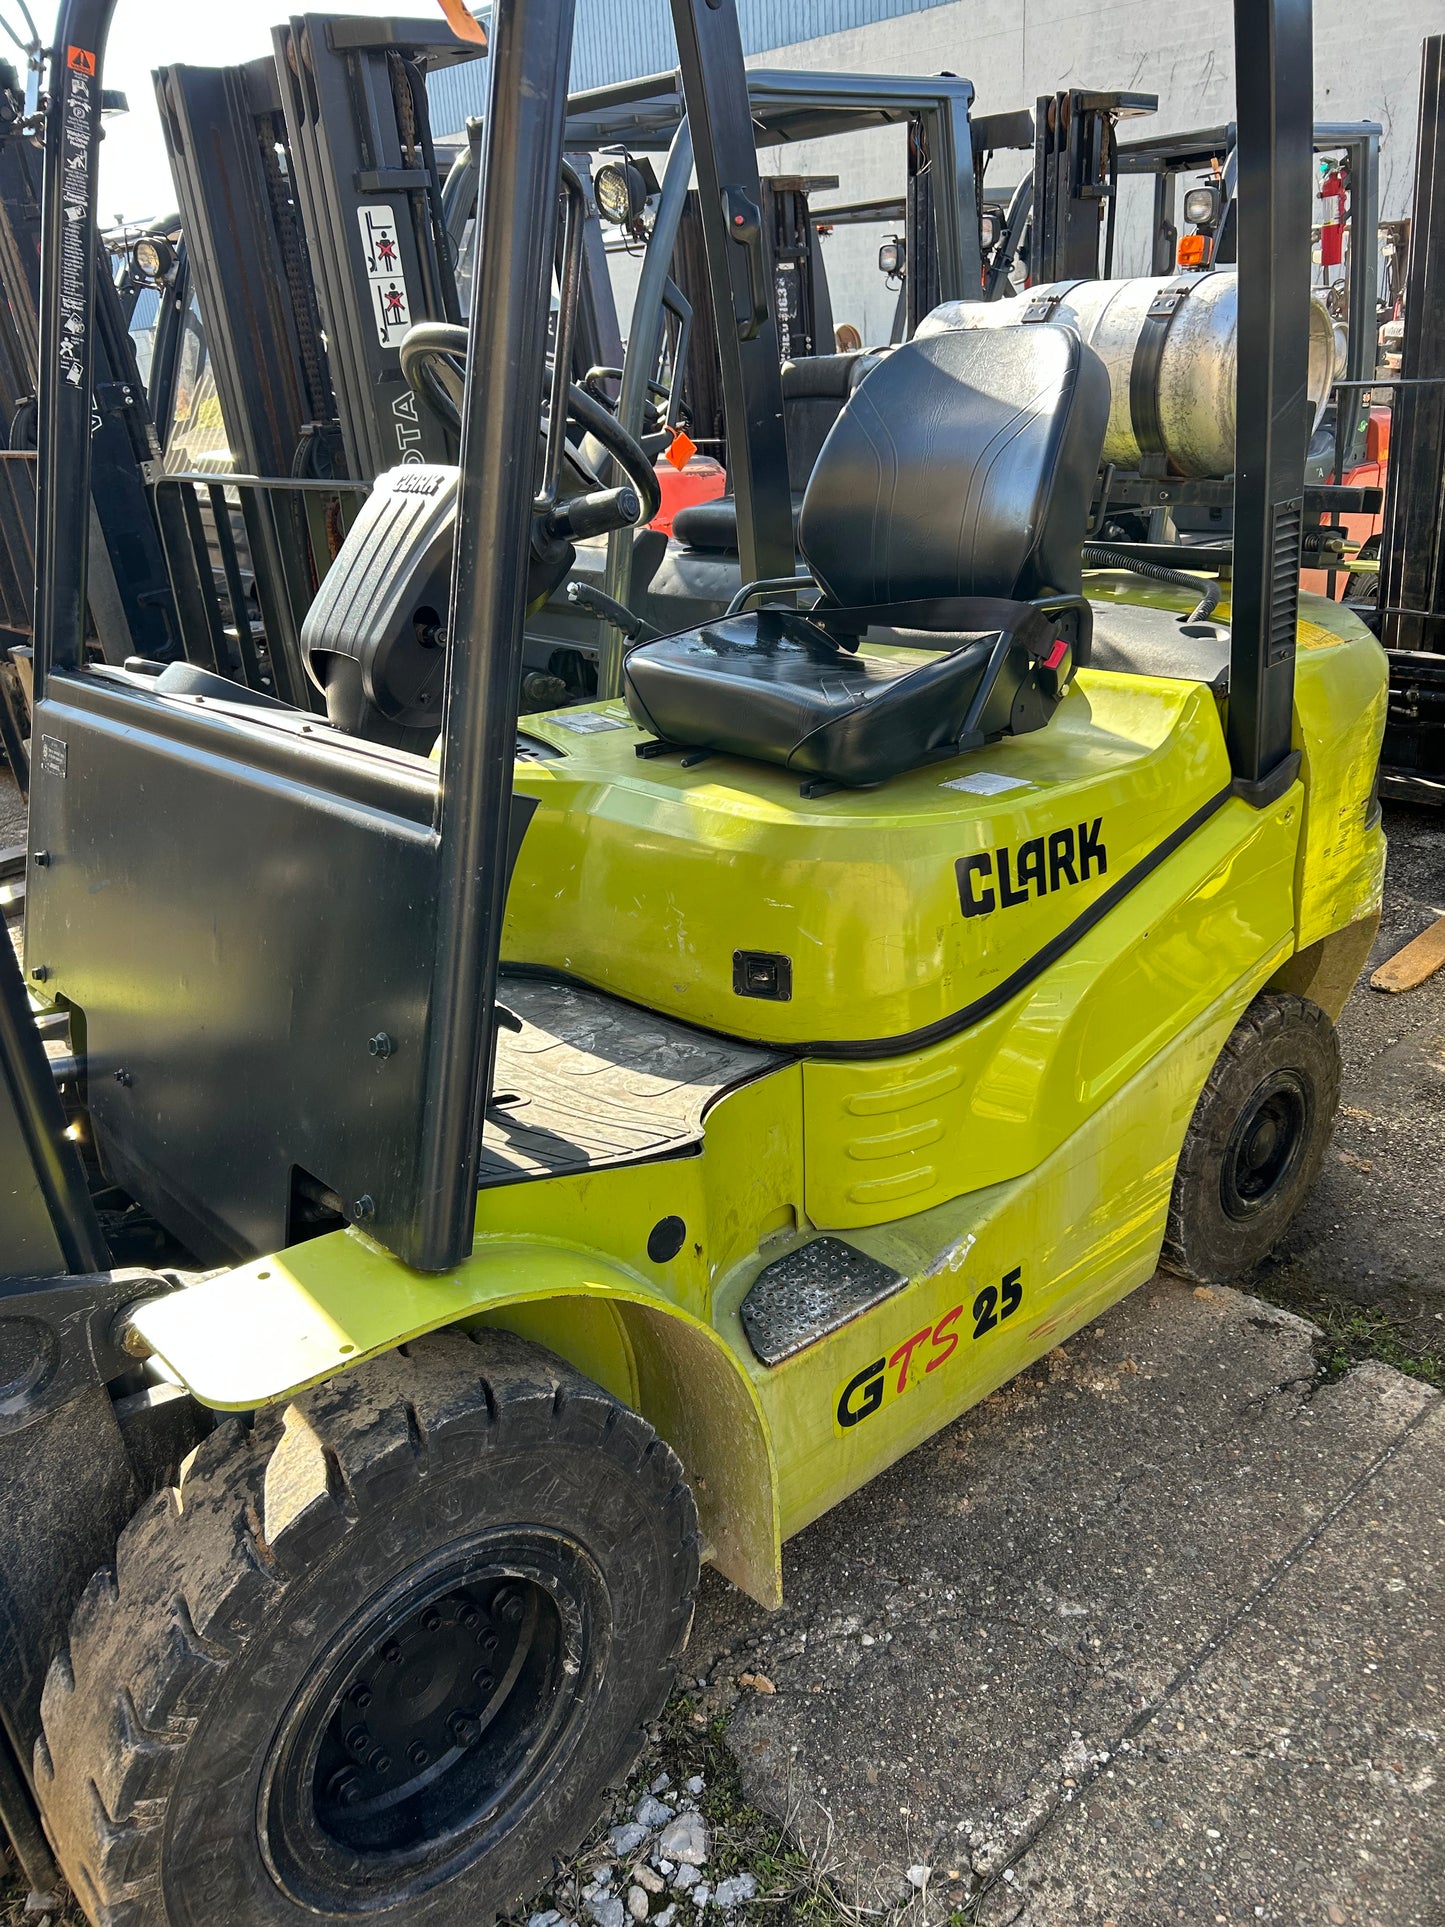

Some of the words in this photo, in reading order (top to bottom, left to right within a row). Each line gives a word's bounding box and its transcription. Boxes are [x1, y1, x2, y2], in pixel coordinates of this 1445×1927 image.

[954, 816, 1107, 918] CLARK
[837, 1305, 963, 1427] GTS
[973, 1266, 1022, 1339] 25
